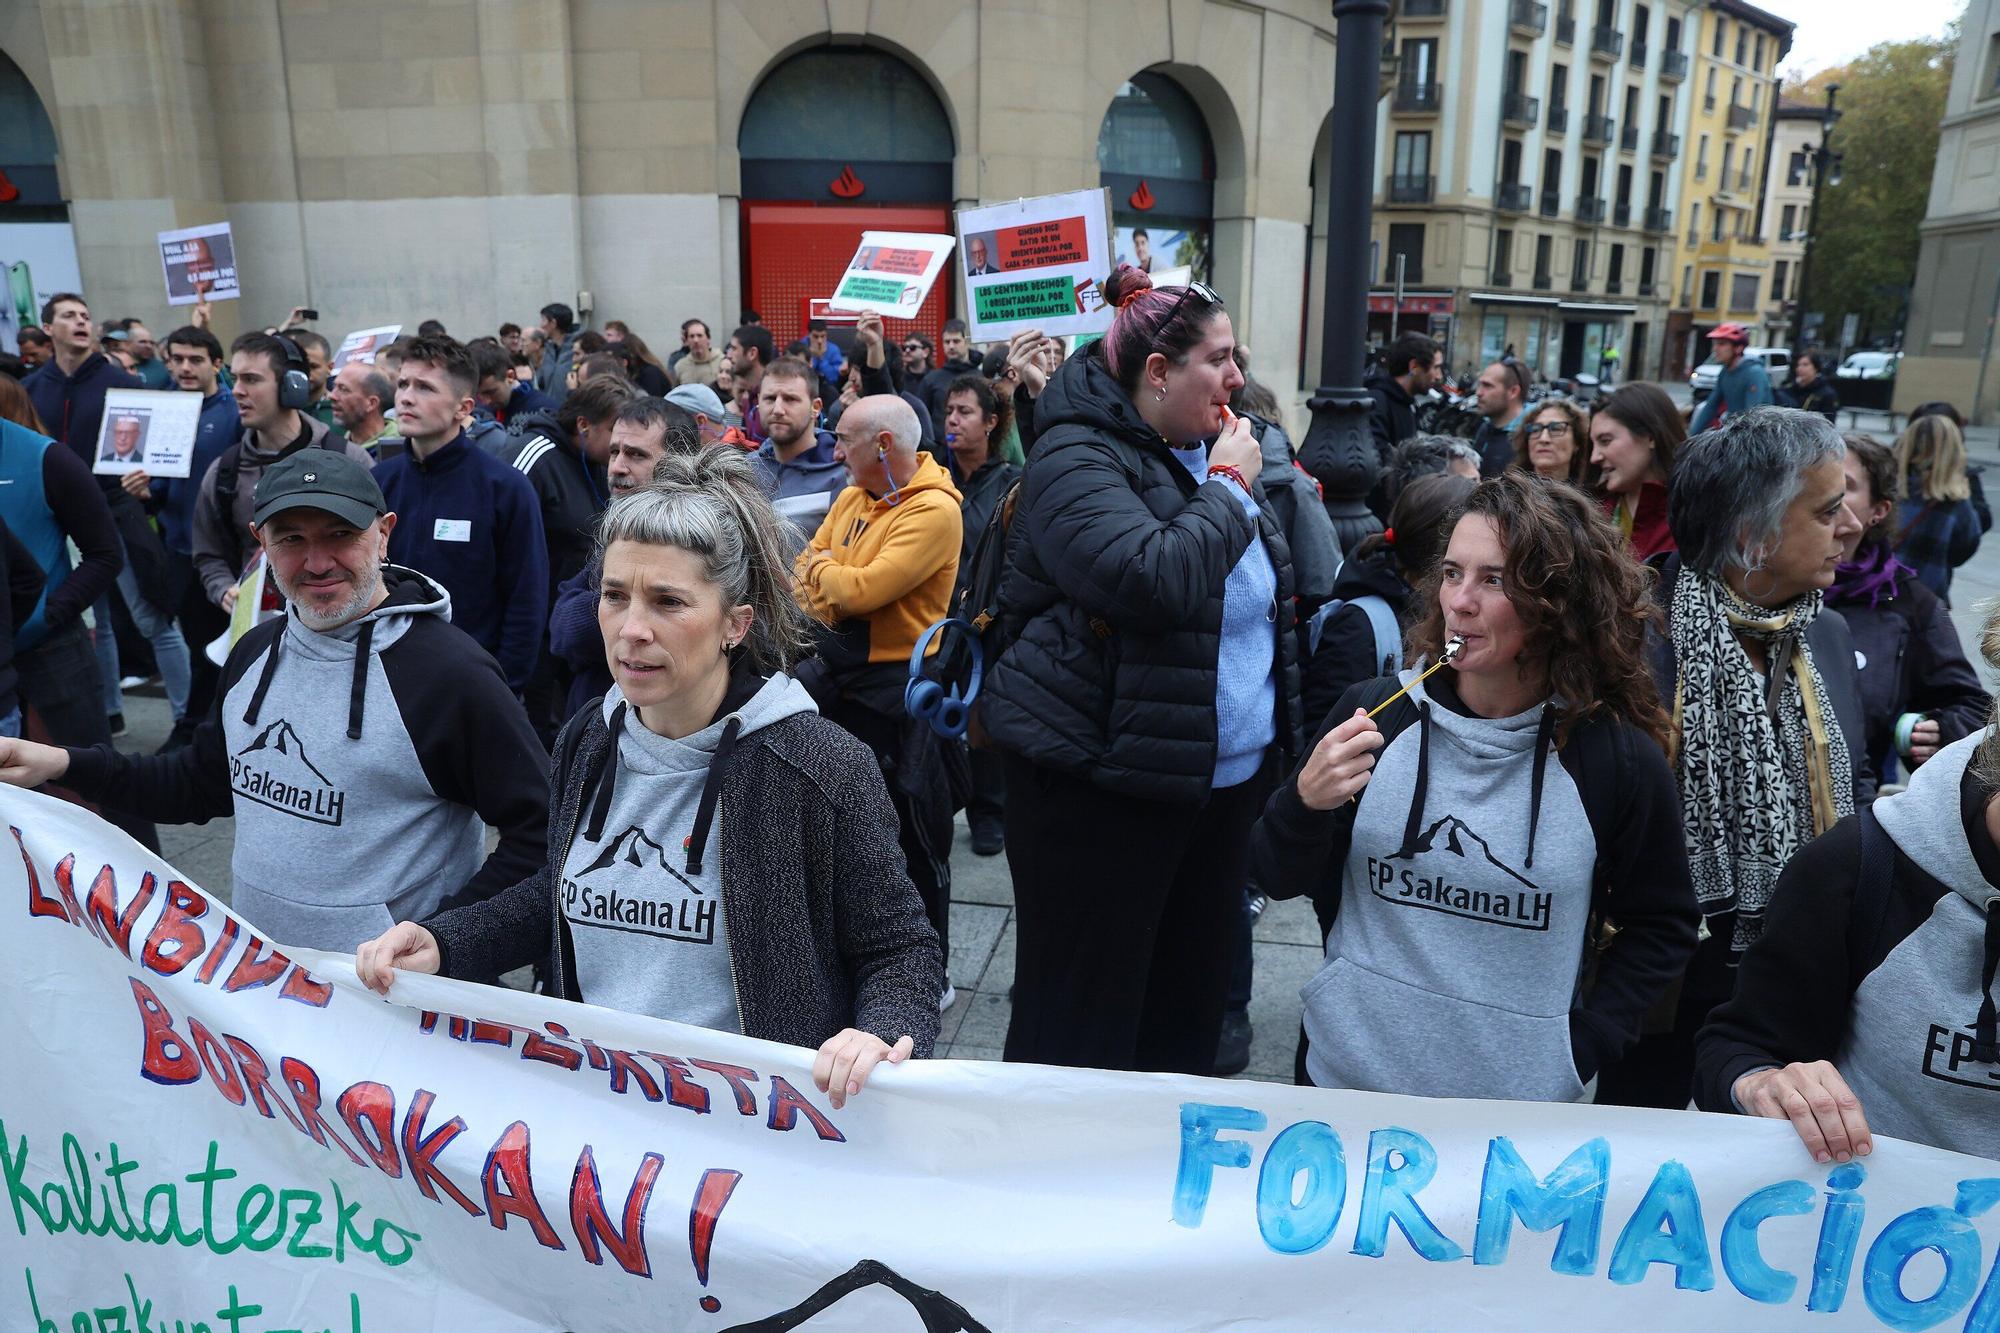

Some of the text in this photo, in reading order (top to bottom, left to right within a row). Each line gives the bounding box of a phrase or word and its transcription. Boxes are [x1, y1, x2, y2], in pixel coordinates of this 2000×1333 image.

[1017, 226, 1043, 236] GIMENO
[1020, 233, 1061, 246] RATIO DE UN
[1010, 242, 1073, 258] ORIENTADOR/A POR
[1005, 259, 1021, 269] CADA
[1036, 252, 1082, 265] ESTUDIANTES
[979, 286, 992, 297] LOS
[994, 282, 1029, 295] CENTROS
[1081, 289, 1103, 304] FP
[989, 293, 1046, 308] ORIENTADOR/A
[1048, 291, 1064, 302] POR
[979, 310, 998, 321] CADA
[1000, 308, 1015, 319] 500
[241, 765, 312, 811] Sakana
[314, 789, 344, 818] LH
[1367, 857, 1552, 923] FP Sakana LH
[580, 887, 674, 929] Sakana
[678, 898, 717, 936] LH
[1922, 1023, 1977, 1074] FP
[129, 975, 743, 1314] BORROKAN!
[0, 1117, 422, 1266] Kalitatezko
[1173, 1101, 2000, 1333] FORMACIÓ
